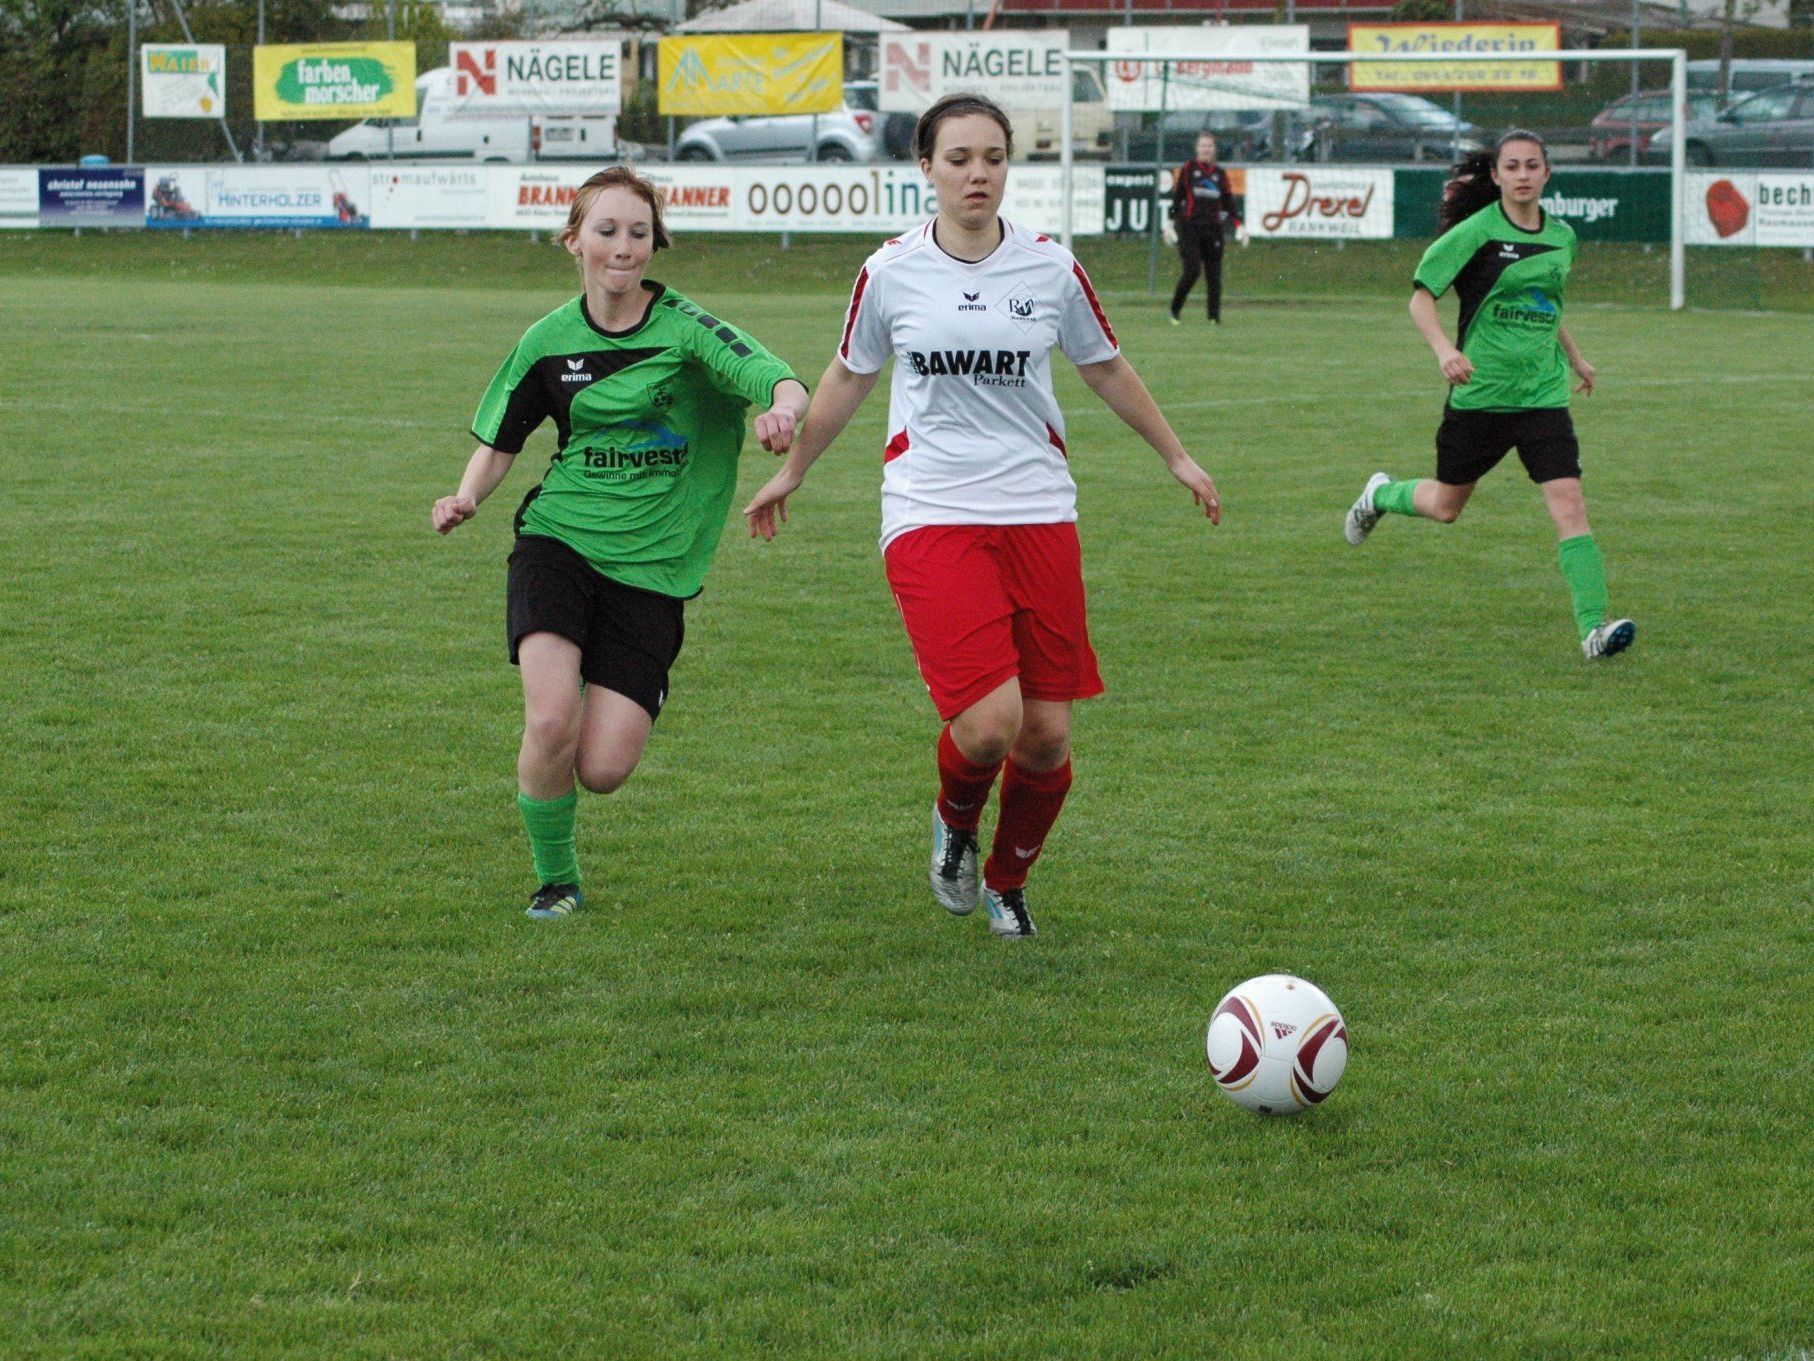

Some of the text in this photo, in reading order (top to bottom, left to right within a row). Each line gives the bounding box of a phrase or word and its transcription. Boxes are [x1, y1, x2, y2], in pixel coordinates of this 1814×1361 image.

[507, 48, 615, 81] NÄGELE
[943, 41, 1062, 77] NÄGELE
[297, 59, 350, 84] farben
[304, 77, 380, 104] morscher
[219, 194, 322, 207] HINTERHOLZER
[1262, 172, 1375, 232] Drexel
[958, 303, 987, 312] erima
[908, 350, 1031, 377] BAWART
[561, 372, 592, 382] erima
[973, 374, 1026, 388] Parkett
[584, 445, 683, 468] fairvest
[584, 469, 627, 480] Gewinne
